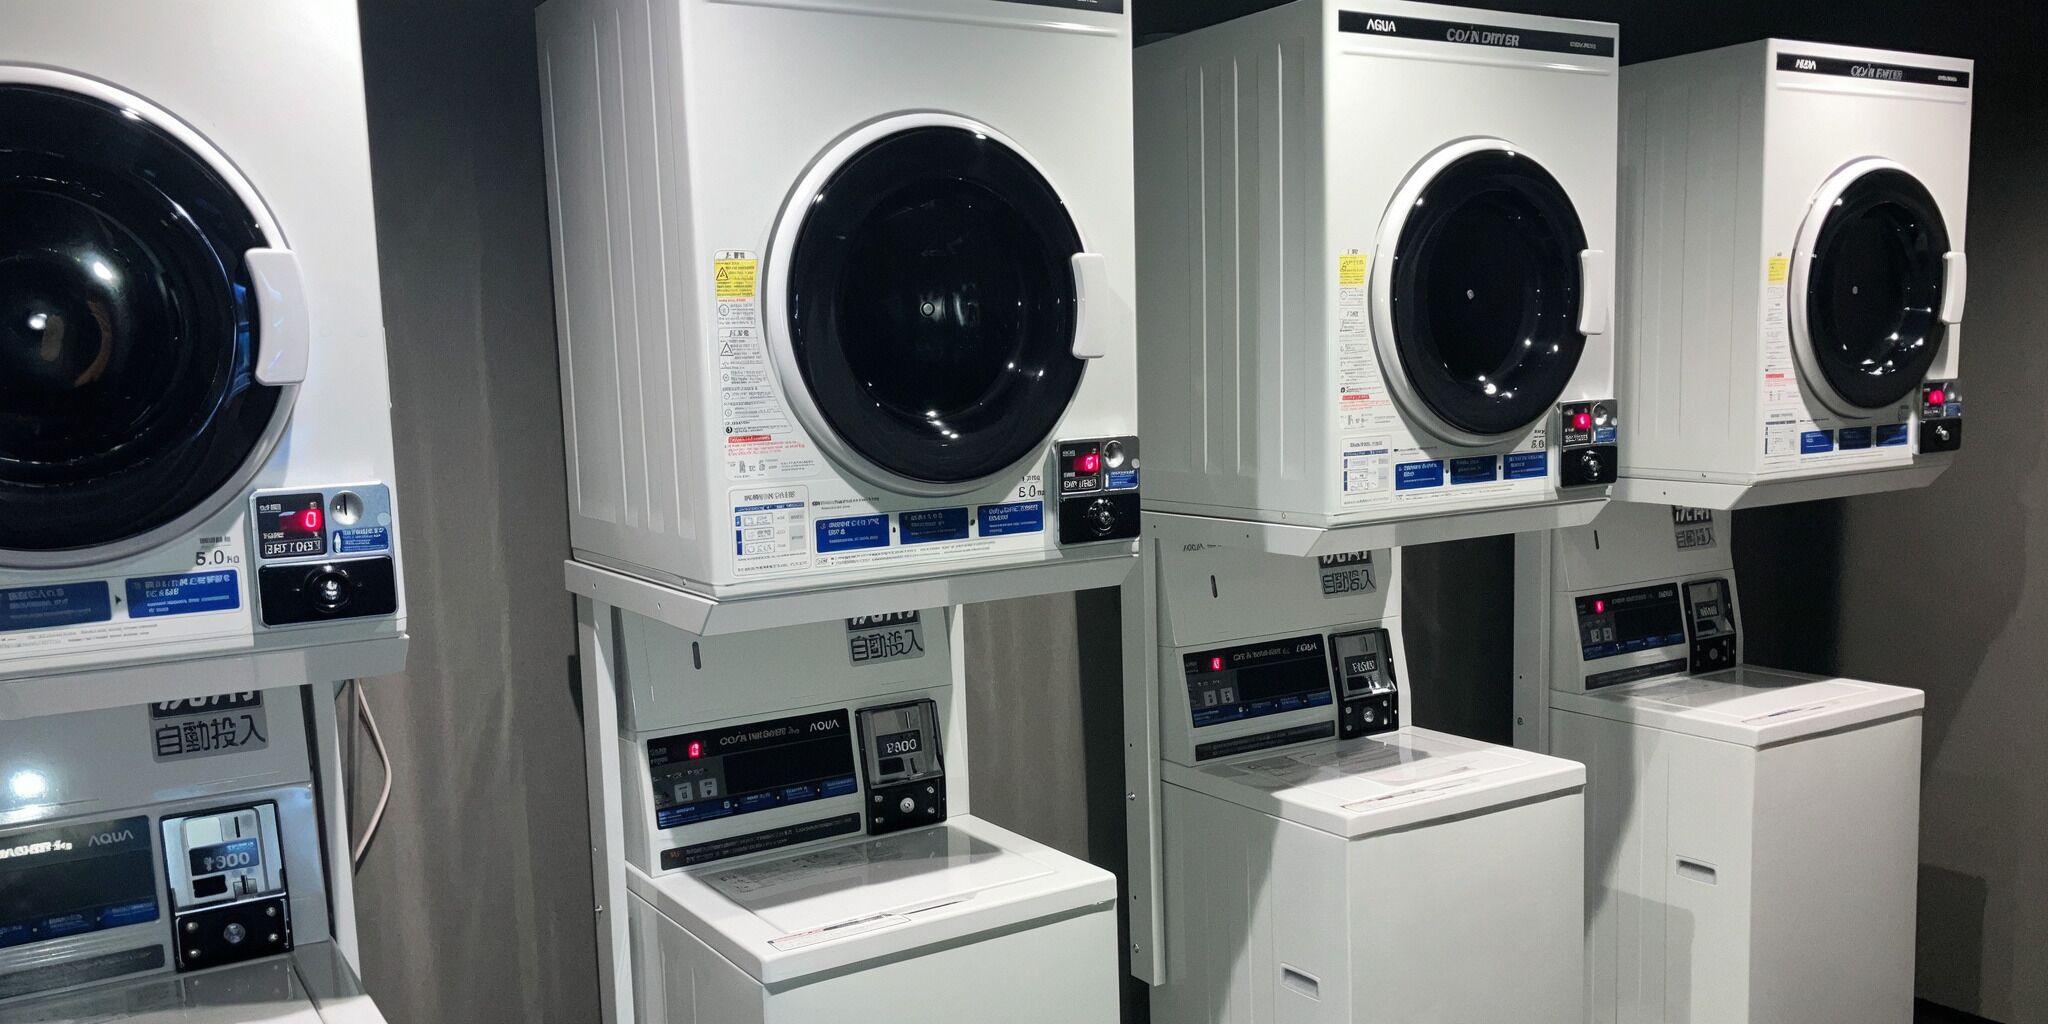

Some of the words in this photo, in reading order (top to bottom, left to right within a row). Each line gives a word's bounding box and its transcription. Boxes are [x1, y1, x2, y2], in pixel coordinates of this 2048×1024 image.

[305, 511, 317, 528] 0
[195, 549, 225, 566] 5.0
[155, 714, 267, 757] 自動投入
[87, 829, 134, 848] AQUA
